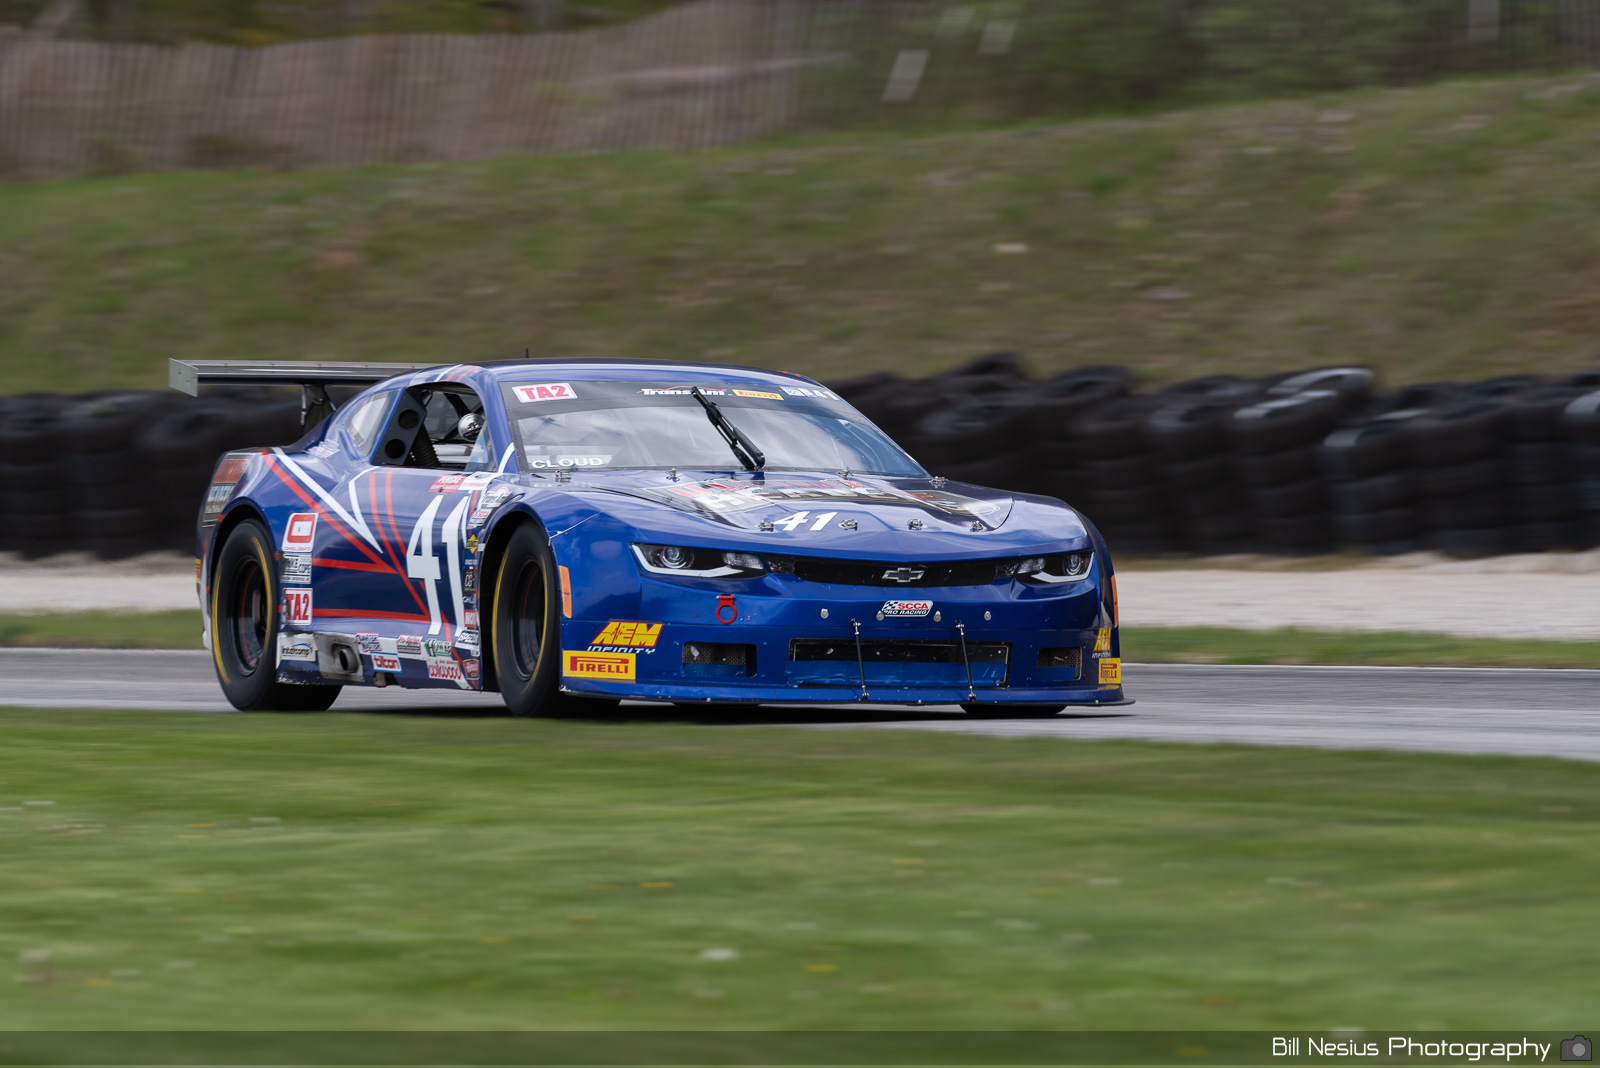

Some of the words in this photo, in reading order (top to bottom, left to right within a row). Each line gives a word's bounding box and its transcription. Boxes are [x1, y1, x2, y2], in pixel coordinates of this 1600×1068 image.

[520, 385, 571, 400] TA2
[531, 457, 604, 470] CLOUD
[773, 511, 838, 531] 41
[406, 494, 470, 637] 41
[286, 593, 310, 621] TA2
[589, 621, 664, 647] AEM
[587, 645, 656, 654] INFINITY
[570, 656, 630, 674] PIRELLI
[1100, 663, 1118, 679] PIRELLI
